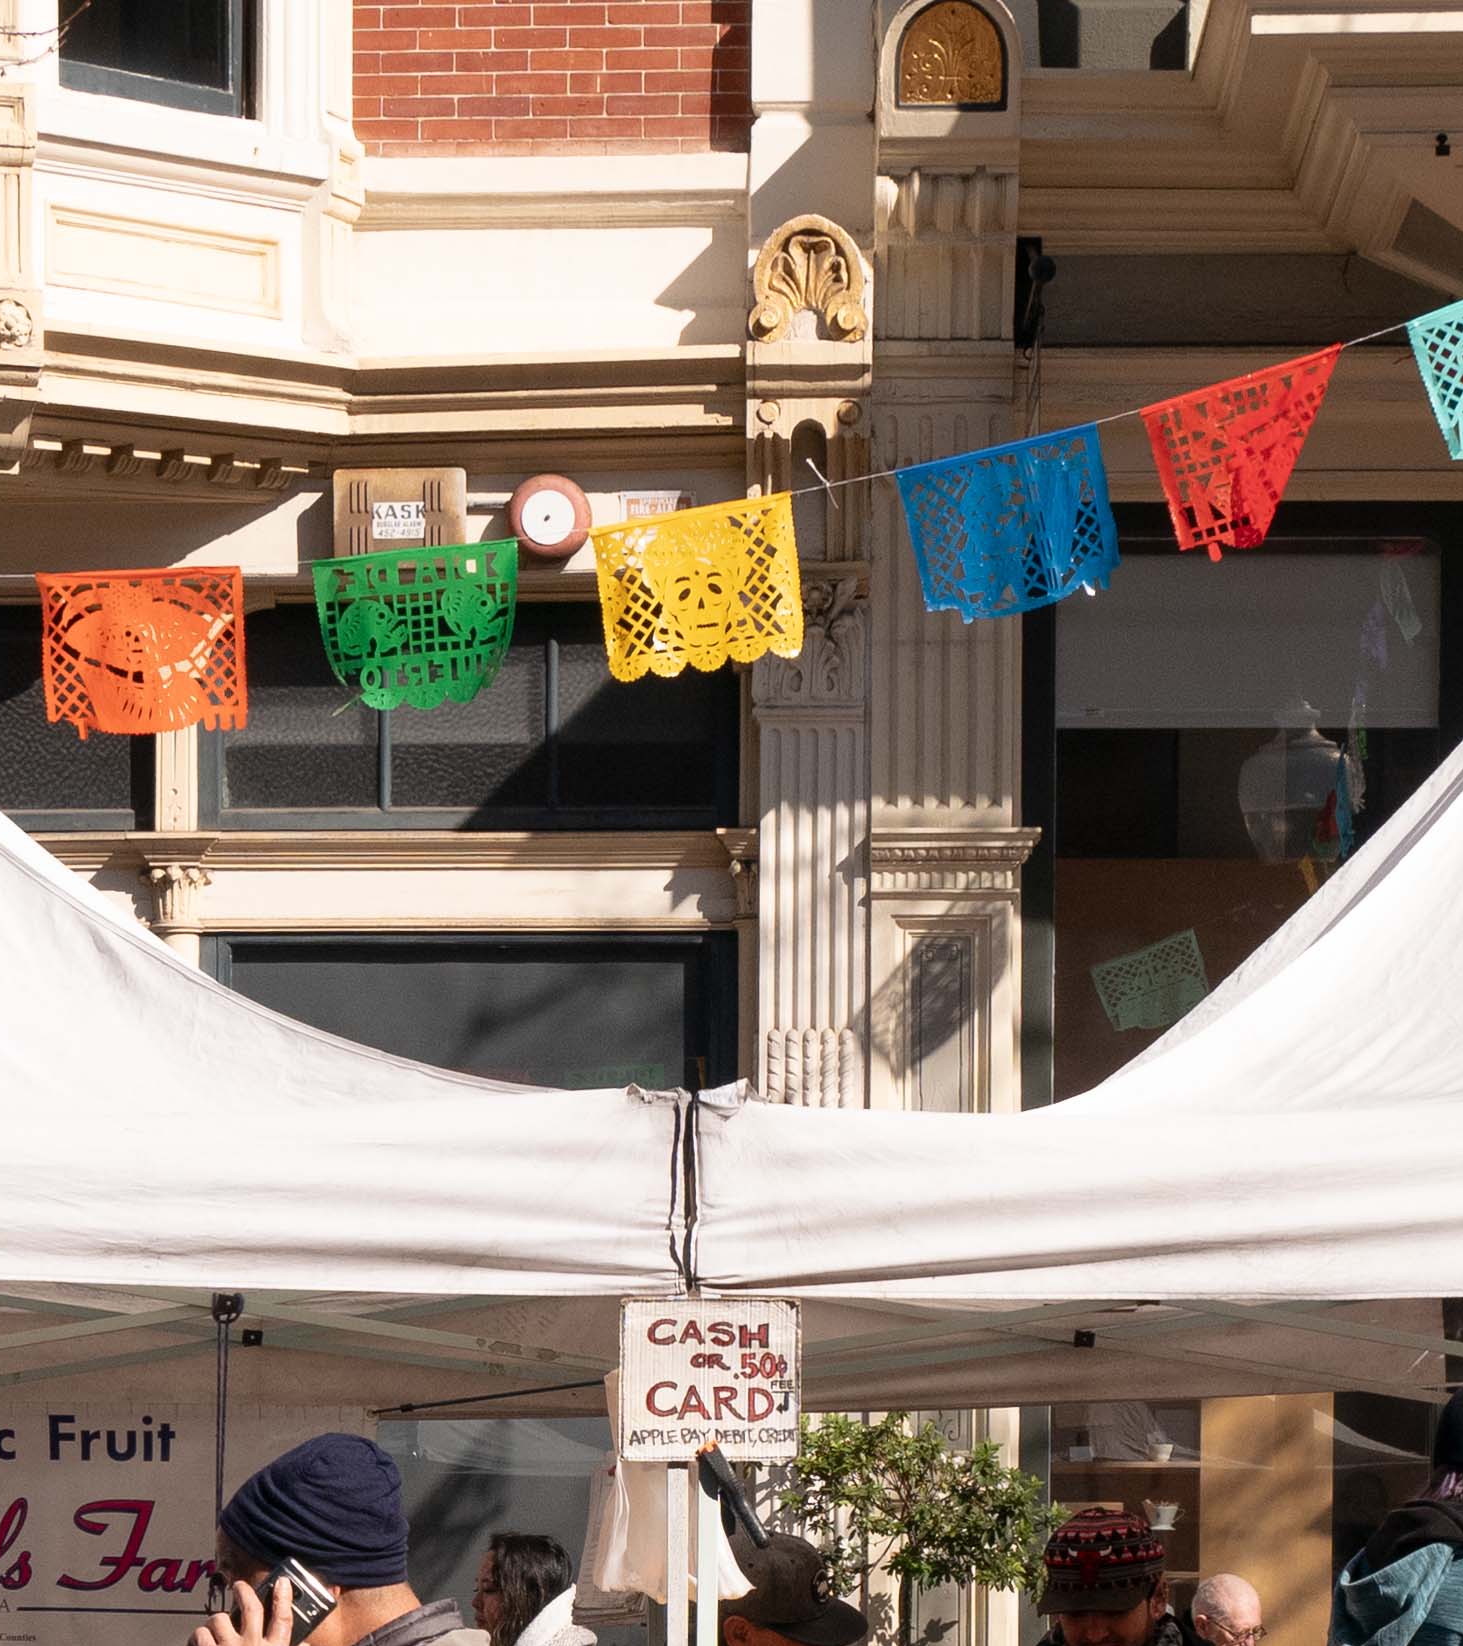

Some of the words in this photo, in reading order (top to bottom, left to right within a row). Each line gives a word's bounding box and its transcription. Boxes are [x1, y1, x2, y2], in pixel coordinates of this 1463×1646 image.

[372, 504, 426, 519] KASK
[647, 1318, 770, 1349] CASH
[690, 1353, 731, 1371] OR
[770, 1379, 794, 1390] FEE
[645, 1381, 776, 1423] CARD
[49, 1414, 176, 1463] Fruit
[629, 1429, 680, 1447] APPLE
[681, 1428, 712, 1445] PAY
[758, 1427, 798, 1445] CREDIT
[58, 1499, 217, 1594] Far
[0, 1631, 37, 1642] Counties
